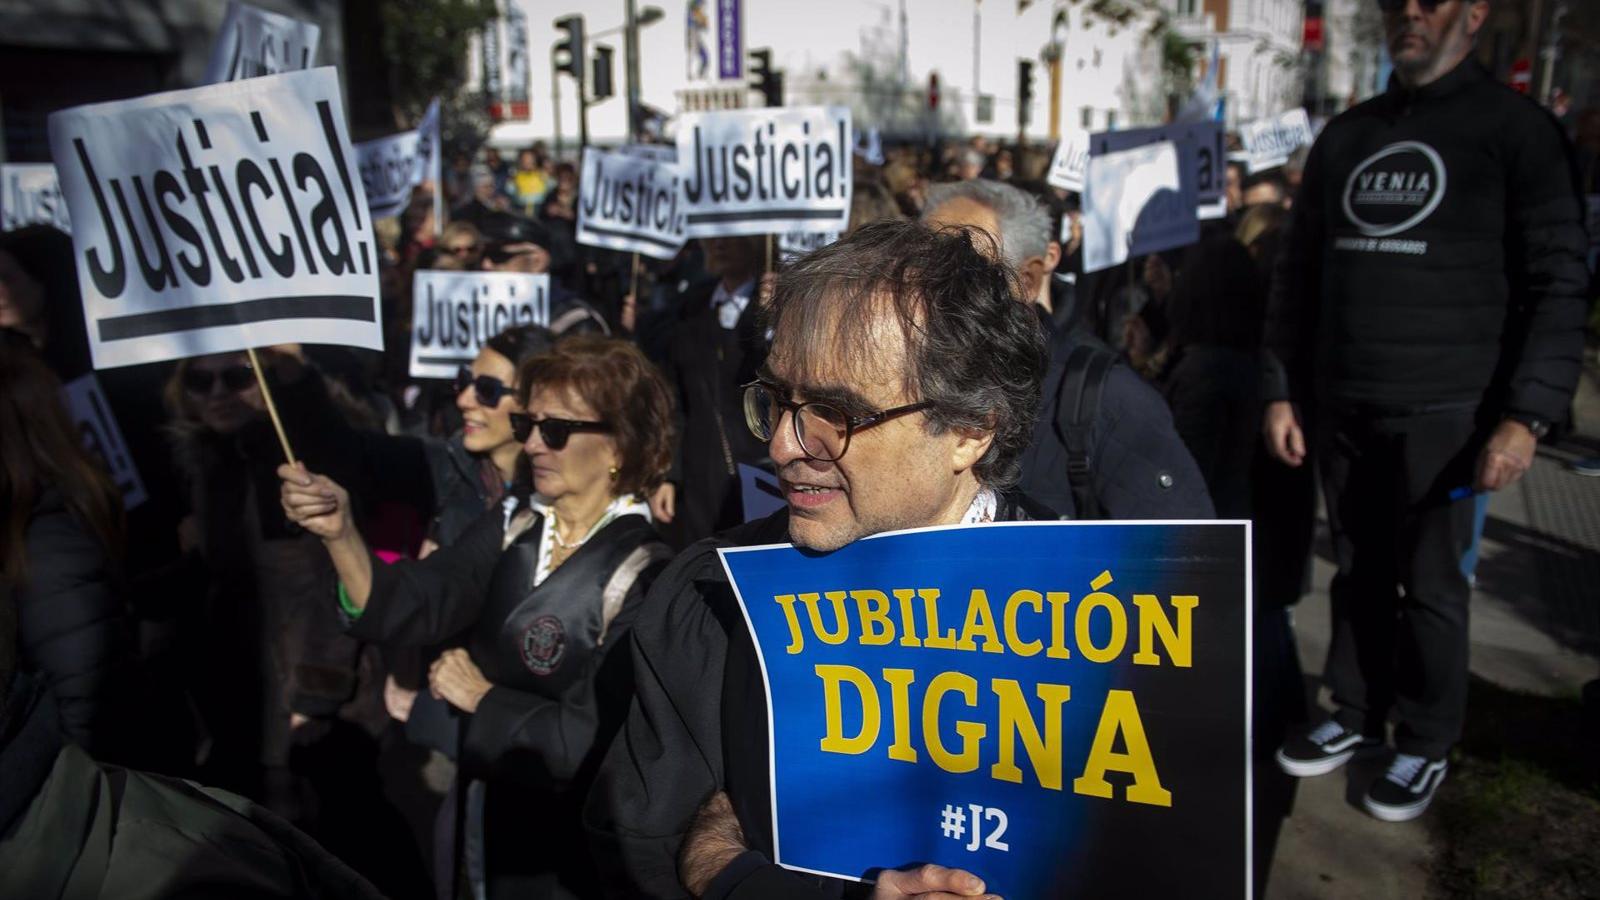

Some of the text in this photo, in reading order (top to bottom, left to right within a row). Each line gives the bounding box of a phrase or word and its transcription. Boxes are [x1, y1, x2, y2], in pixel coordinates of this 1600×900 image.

[73, 99, 372, 299] Justicia!
[583, 158, 684, 236] Justici
[684, 119, 846, 204] Justicia!
[1359, 171, 1431, 192] VENIA
[774, 569, 1200, 669] JUBILACIÓN
[814, 663, 1173, 808] DIGNA
[940, 803, 1010, 852] #J2
